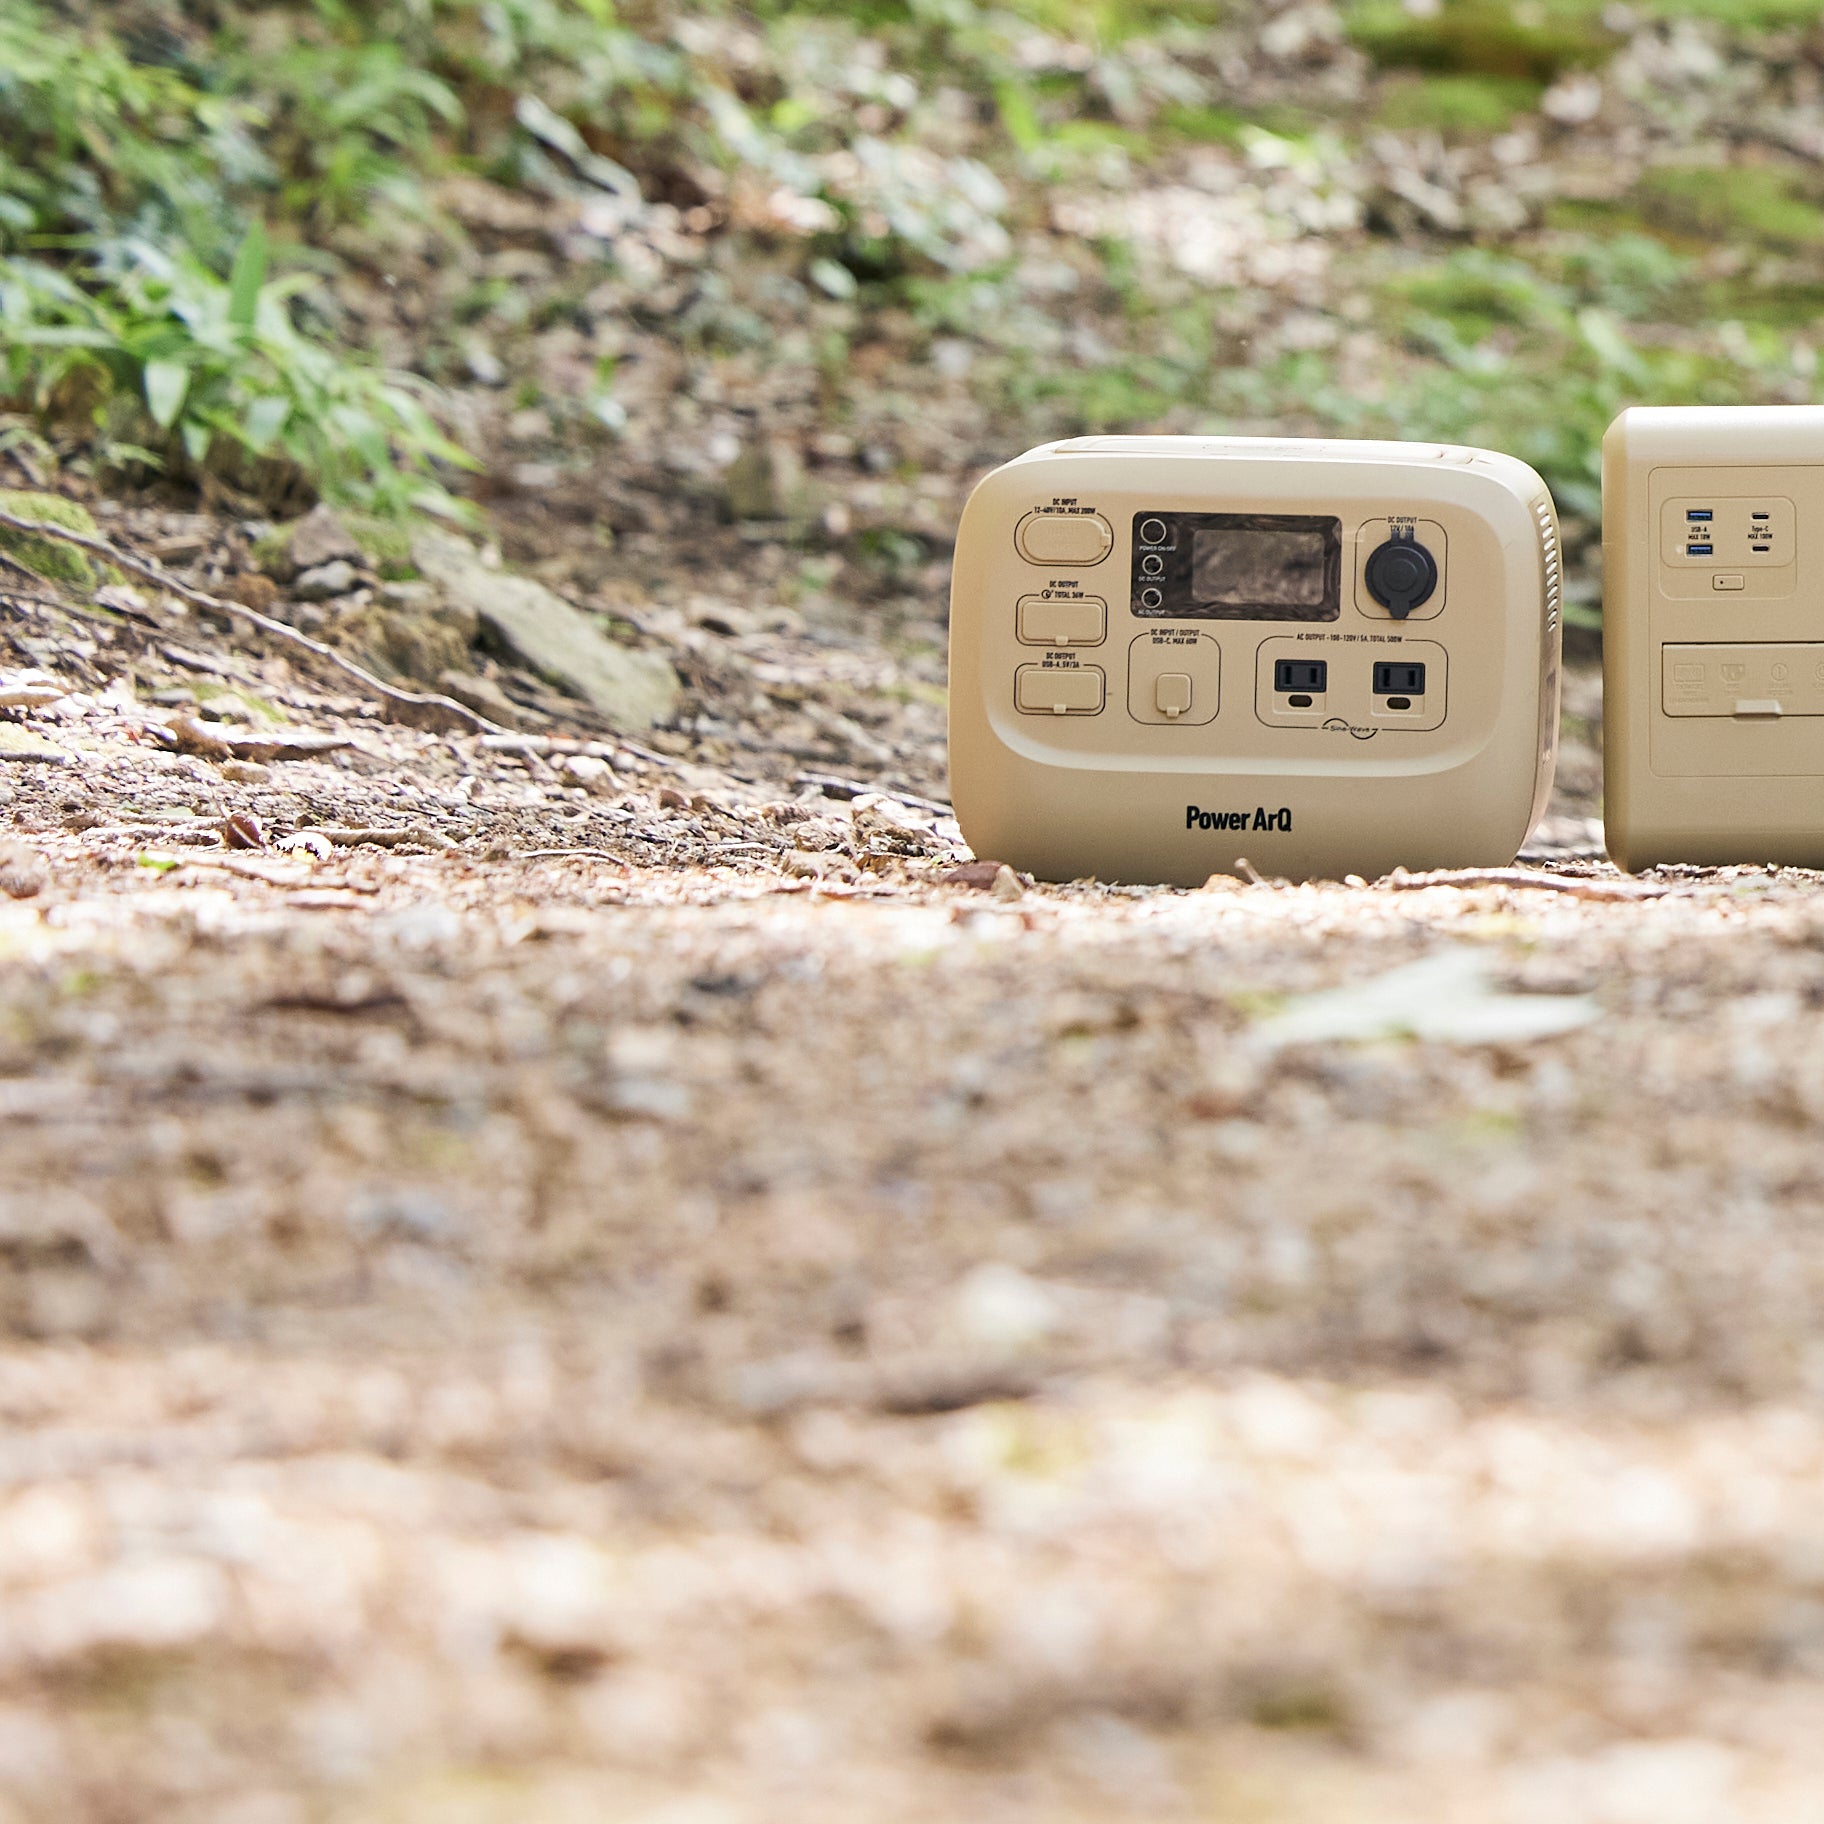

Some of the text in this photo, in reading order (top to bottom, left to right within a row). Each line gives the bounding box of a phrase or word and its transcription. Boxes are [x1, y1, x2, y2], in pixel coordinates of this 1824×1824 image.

[1396, 516, 1418, 524] OUTPUT
[1752, 525, 1769, 533] Type-C
[1055, 591, 1070, 599] TOTAL
[1296, 633, 1304, 641] AC
[1305, 633, 1326, 641] OUTPUT
[1370, 635, 1385, 643] TOTAL
[1186, 805, 1292, 832] Power ArQ
